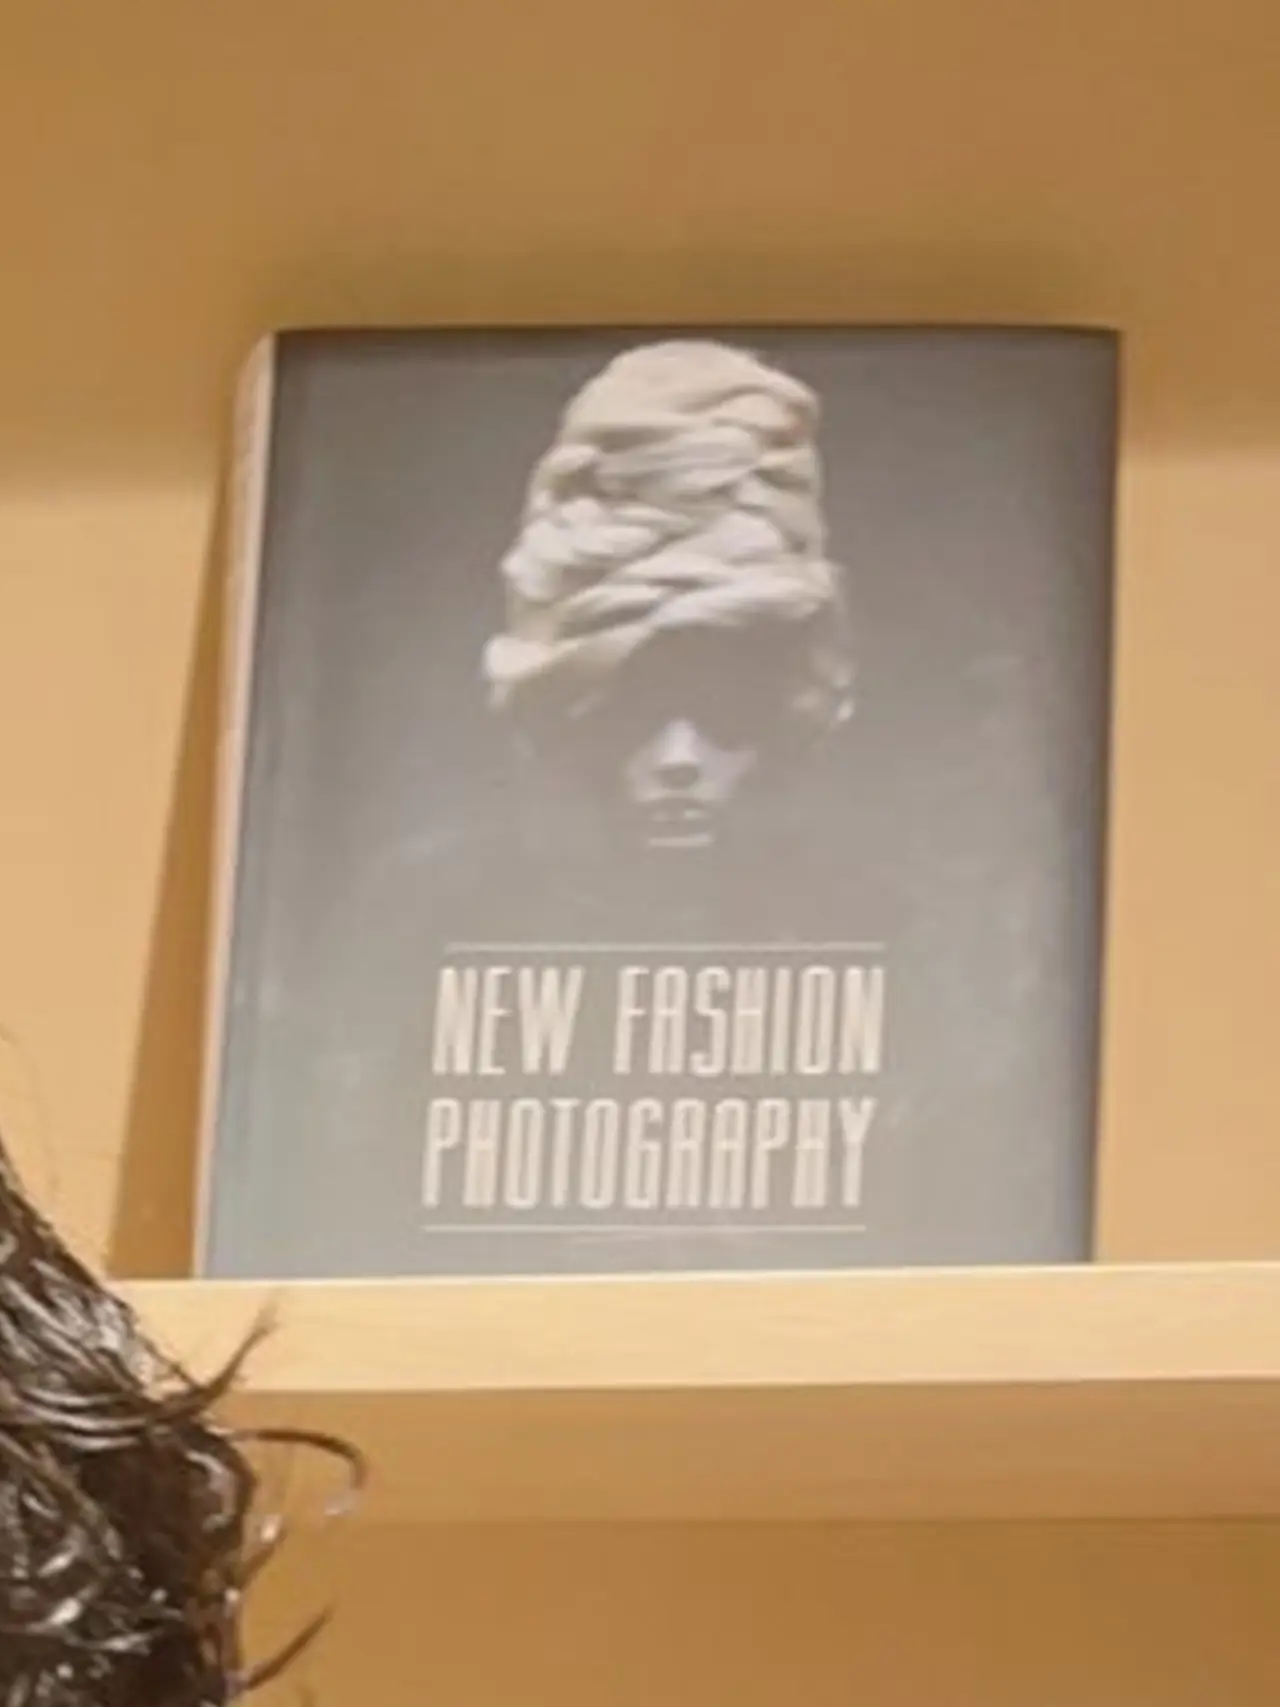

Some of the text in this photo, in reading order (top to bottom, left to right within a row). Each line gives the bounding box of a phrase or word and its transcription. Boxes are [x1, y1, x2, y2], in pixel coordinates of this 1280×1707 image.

[431, 964, 887, 1077] NEW FASHION
[420, 1097, 880, 1210] PHOTOGRAPHY
